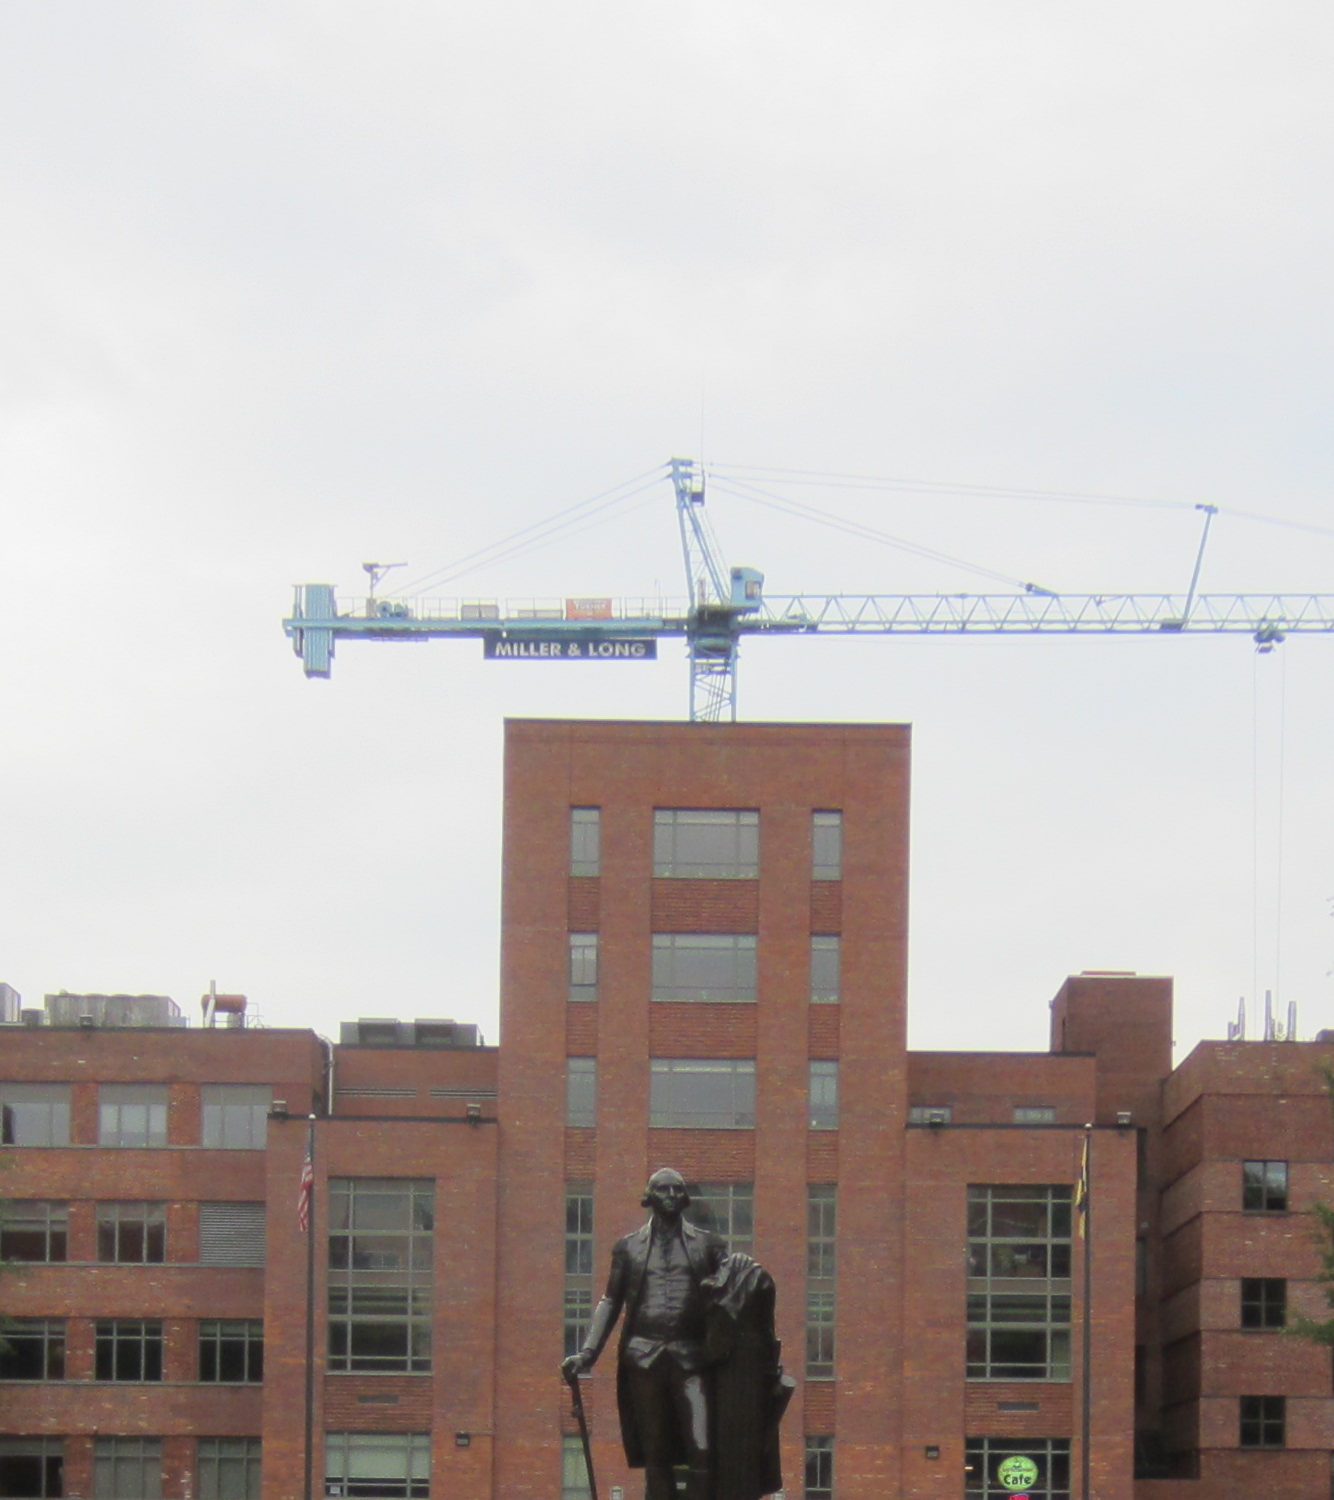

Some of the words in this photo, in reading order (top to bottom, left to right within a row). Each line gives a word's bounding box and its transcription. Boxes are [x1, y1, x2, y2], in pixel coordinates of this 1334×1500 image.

[495, 642, 561, 656] MILLER
[568, 642, 581, 656] &
[589, 642, 646, 657] LONG
[1003, 1474, 1032, 1485] Cafe
